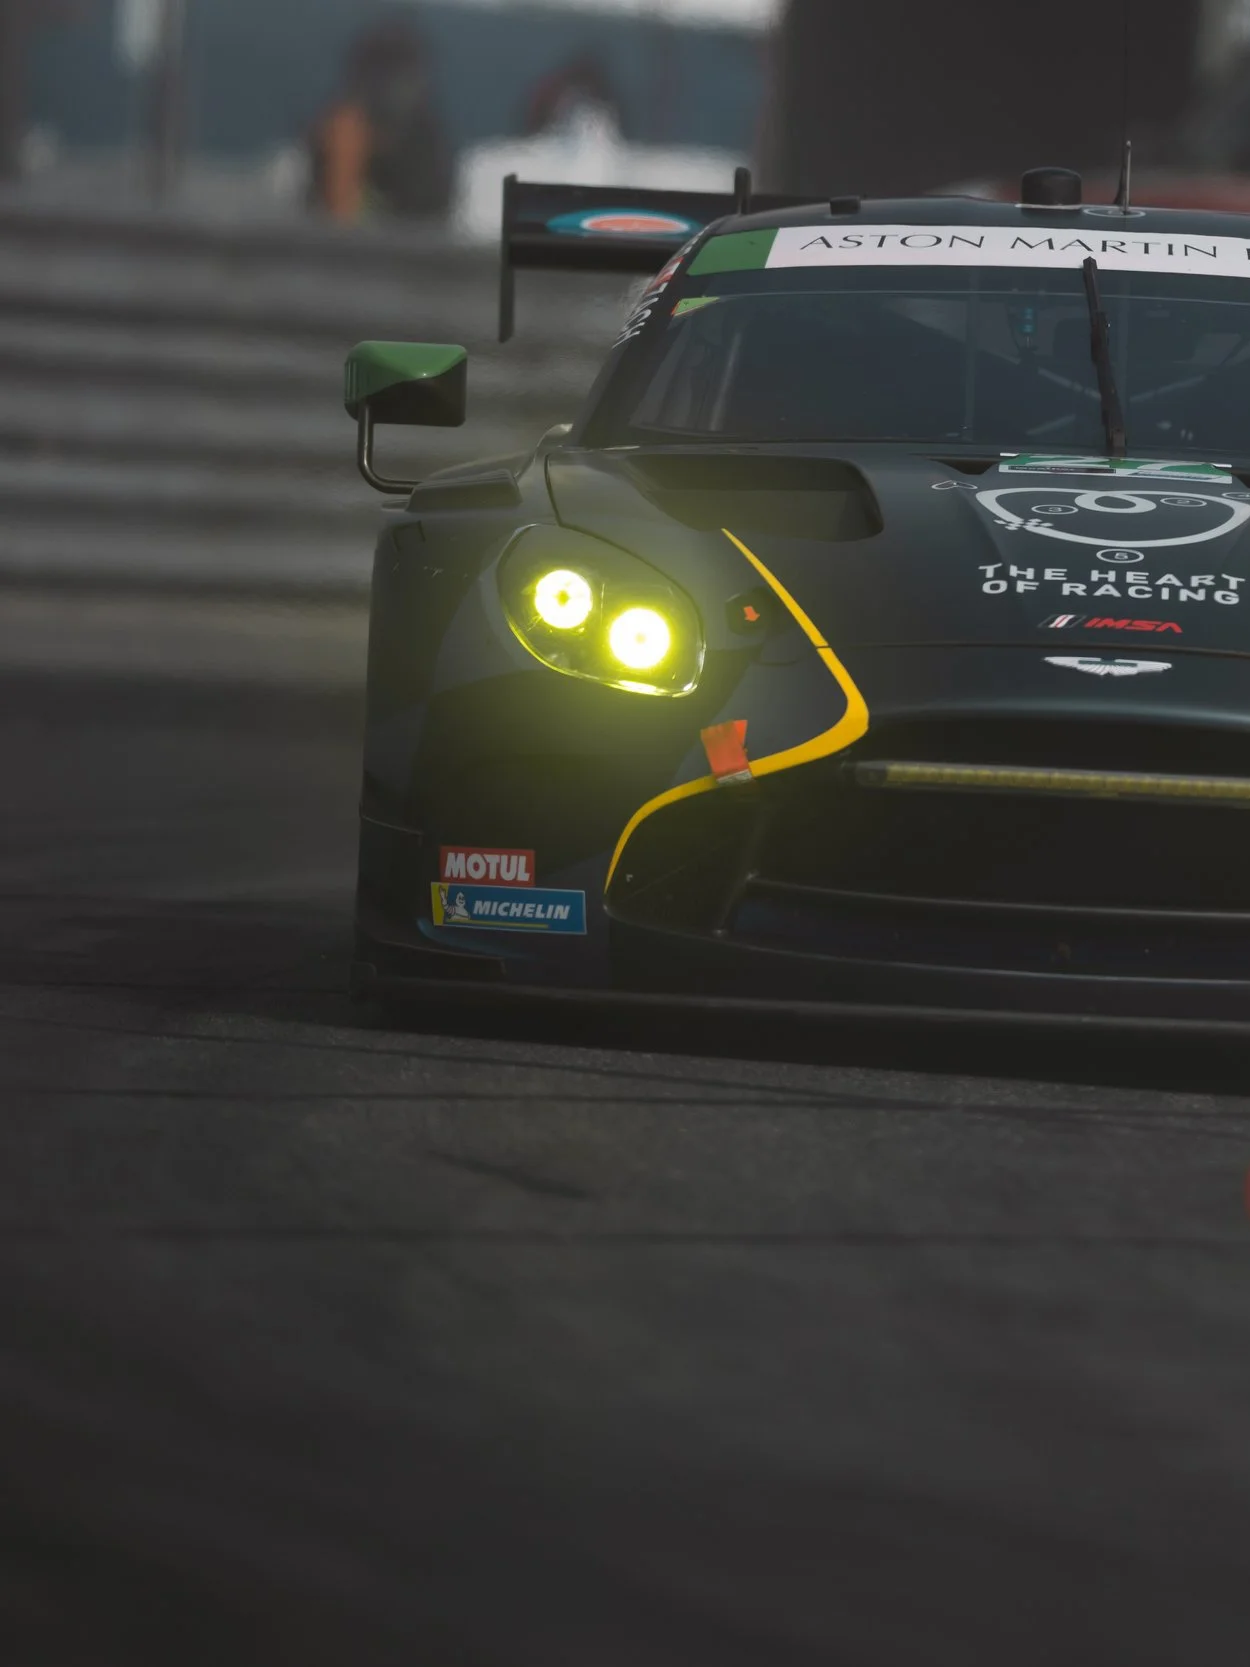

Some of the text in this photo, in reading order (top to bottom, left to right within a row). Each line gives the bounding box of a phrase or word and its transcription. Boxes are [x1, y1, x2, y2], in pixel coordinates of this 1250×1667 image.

[800, 234, 985, 251] ASTON
[1010, 236, 1217, 258] MARTIN
[978, 562, 1246, 591] THE HEART
[982, 579, 1240, 605] OF RACING
[1083, 617, 1183, 634] IMSA
[444, 852, 530, 882] MOTUL
[474, 900, 570, 920] MICHELIN
